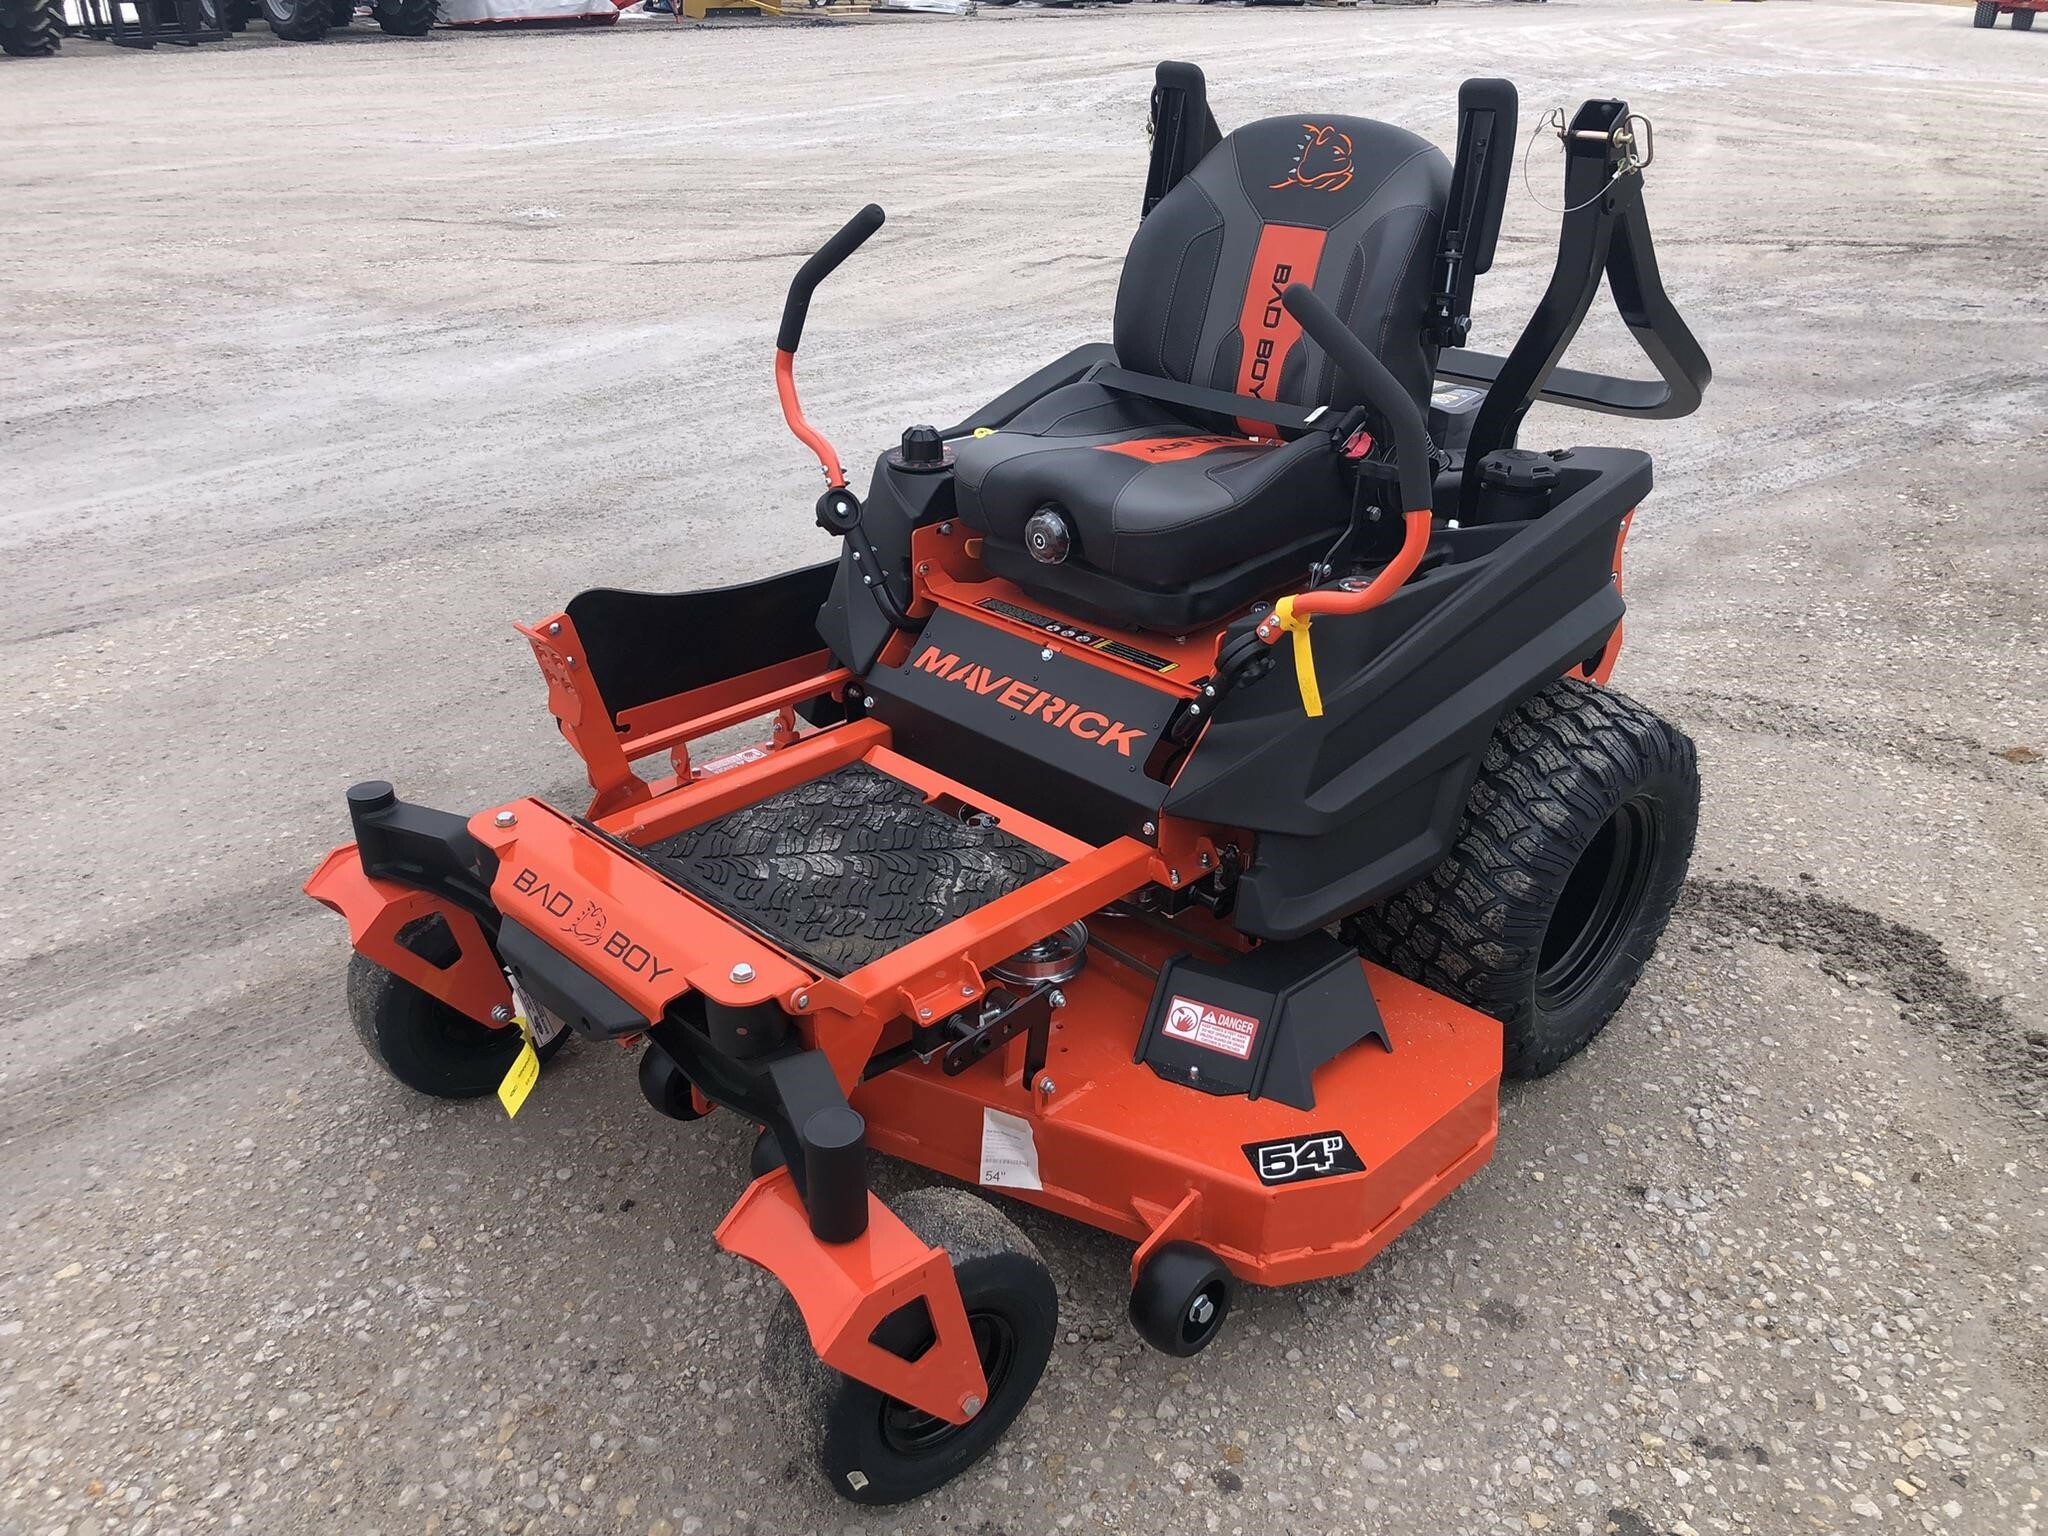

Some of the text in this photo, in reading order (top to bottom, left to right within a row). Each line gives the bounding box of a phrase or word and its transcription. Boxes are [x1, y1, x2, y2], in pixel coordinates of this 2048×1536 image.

[1249, 264, 1292, 399] BAD BOY
[913, 645, 1148, 757] MAVERICK
[513, 868, 674, 983] BAD BOY
[1218, 1013, 1254, 1035] DANGER
[985, 1170, 1006, 1182] 54"
